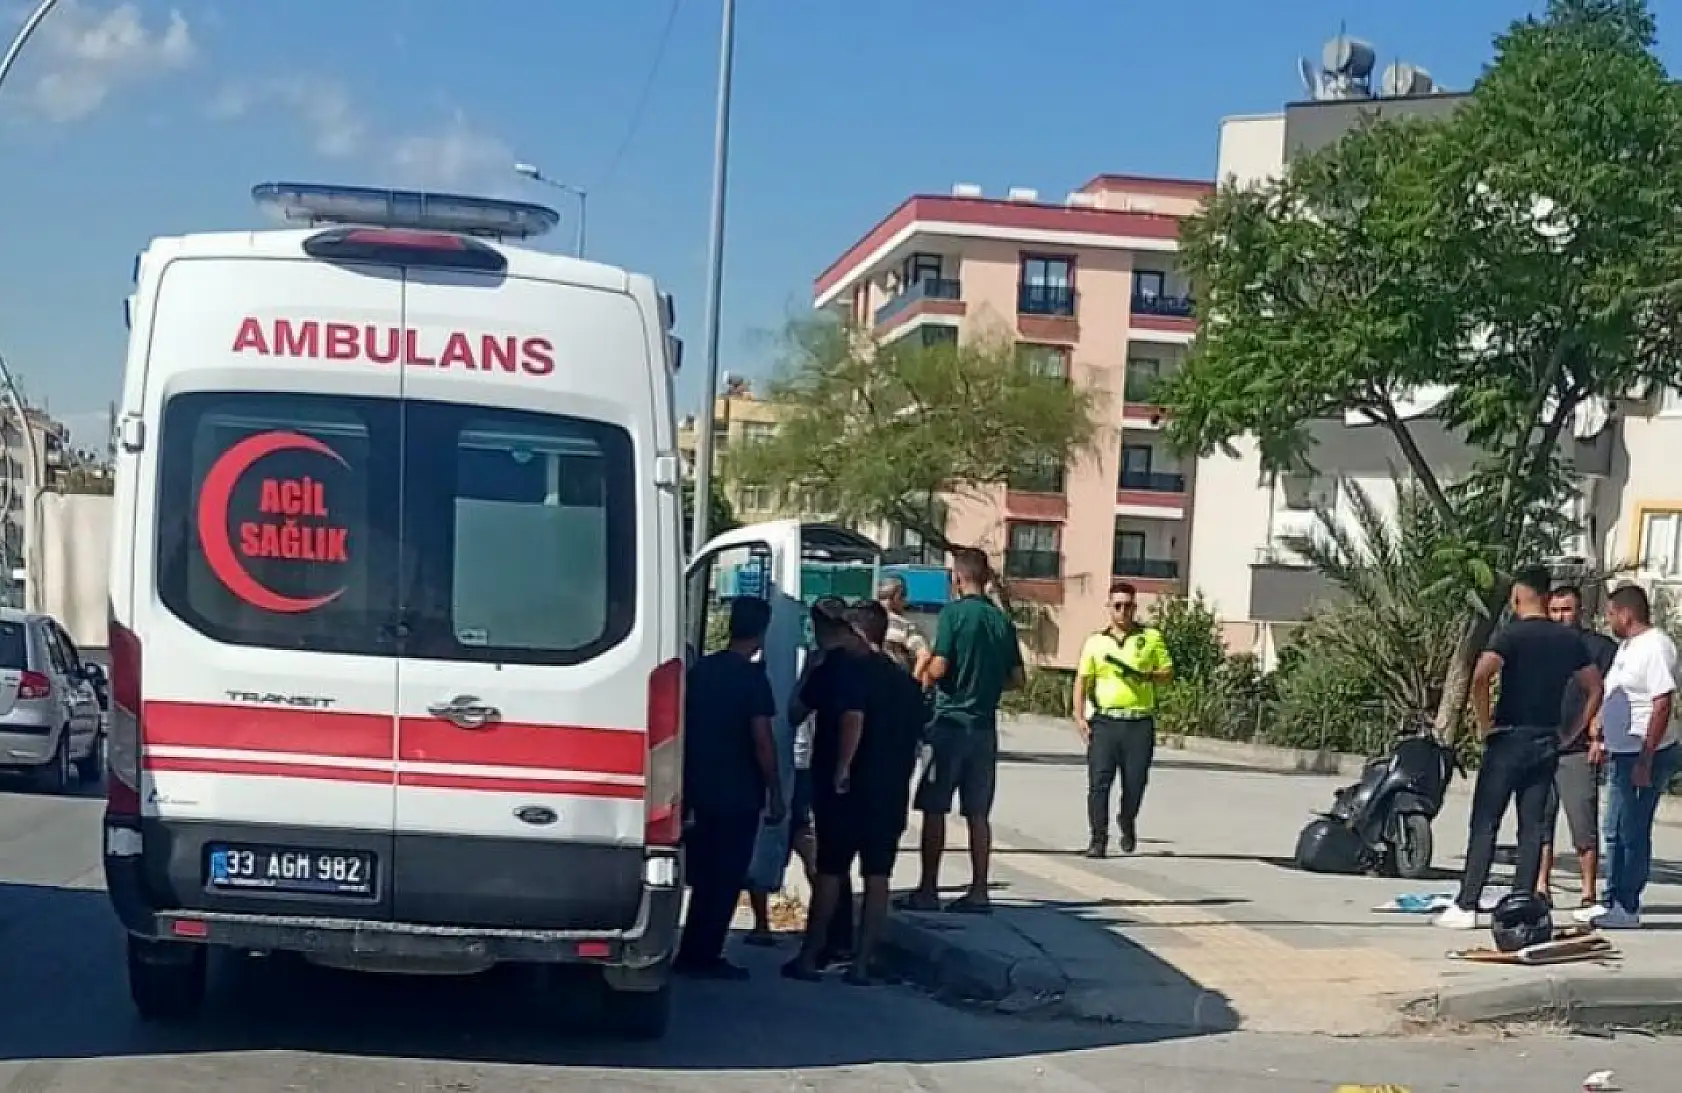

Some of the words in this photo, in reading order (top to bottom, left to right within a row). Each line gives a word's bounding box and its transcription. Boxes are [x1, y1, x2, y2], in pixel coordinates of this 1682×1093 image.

[232, 317, 555, 375] AMBULANS
[241, 519, 348, 561] SAĞLIK
[227, 851, 254, 874] 33
[318, 857, 360, 881] 982
